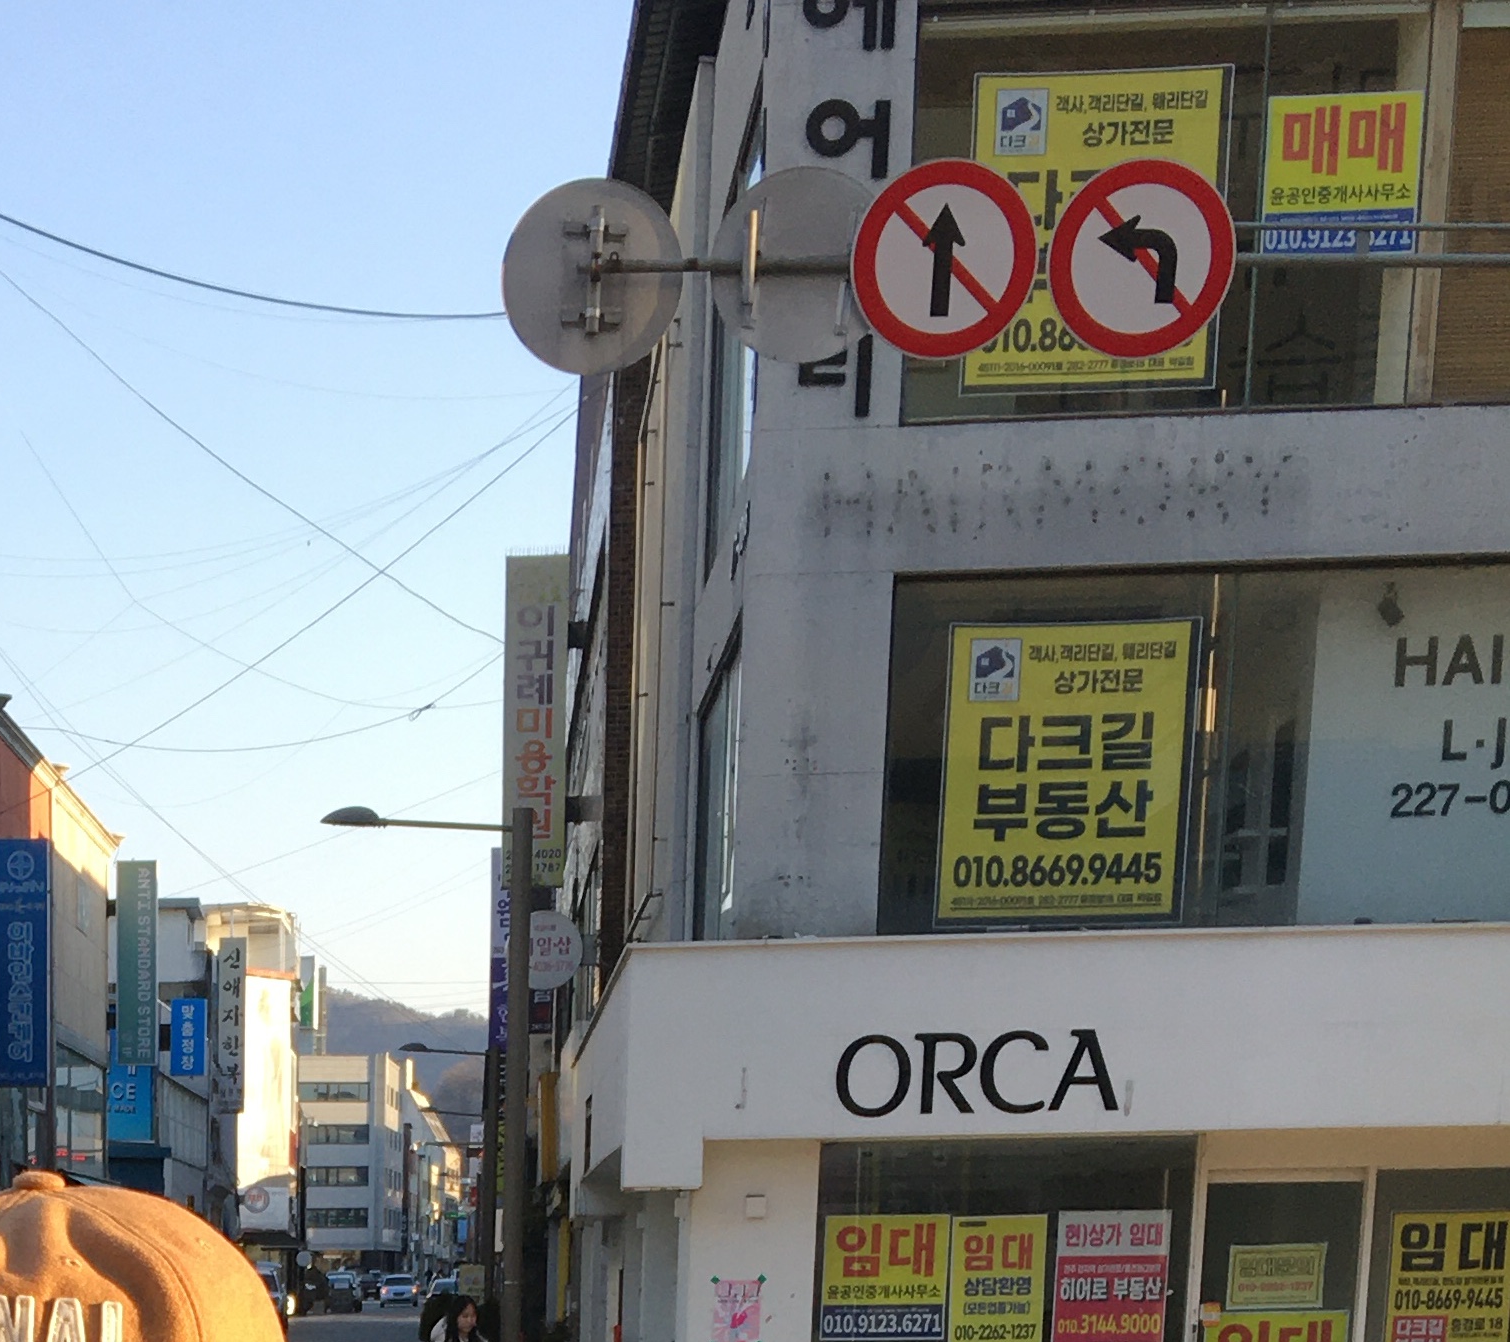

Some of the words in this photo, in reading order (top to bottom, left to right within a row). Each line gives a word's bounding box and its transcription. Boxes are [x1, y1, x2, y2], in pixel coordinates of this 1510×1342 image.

[1082, 118, 1174, 148] 상가전문
[1282, 102, 1407, 176] 매매
[1270, 183, 1412, 206] 윤공인중개사사무소
[1054, 667, 1145, 695] 상가전문
[978, 711, 1156, 773] 다크길
[972, 779, 1154, 843] 부동산
[952, 851, 1163, 888] 010.8669.9445
[137, 867, 152, 912] ANTI
[137, 914, 152, 1002] STANDARD
[137, 1005, 152, 1059] STORE
[835, 1028, 1120, 1118] ORCA
[1129, 1222, 1163, 1247] 임대
[1400, 1220, 1509, 1273] 임대
[836, 1222, 937, 1278] 임대
[964, 1233, 1034, 1271] 임대
[826, 1283, 941, 1300] 윤공인중개사사무소
[964, 1275, 1032, 1297] 상담환영
[1060, 1276, 1109, 1301] 히어로
[1112, 1276, 1163, 1301] 부동산
[1393, 1287, 1505, 1312] 010-8669-9445
[823, 1313, 942, 1335] 010.9123.6271
[954, 1322, 1037, 1342] 010-2262-1237
[1057, 1313, 1162, 1335] 010.3144.9000
[1396, 1318, 1445, 1337] 다크길
